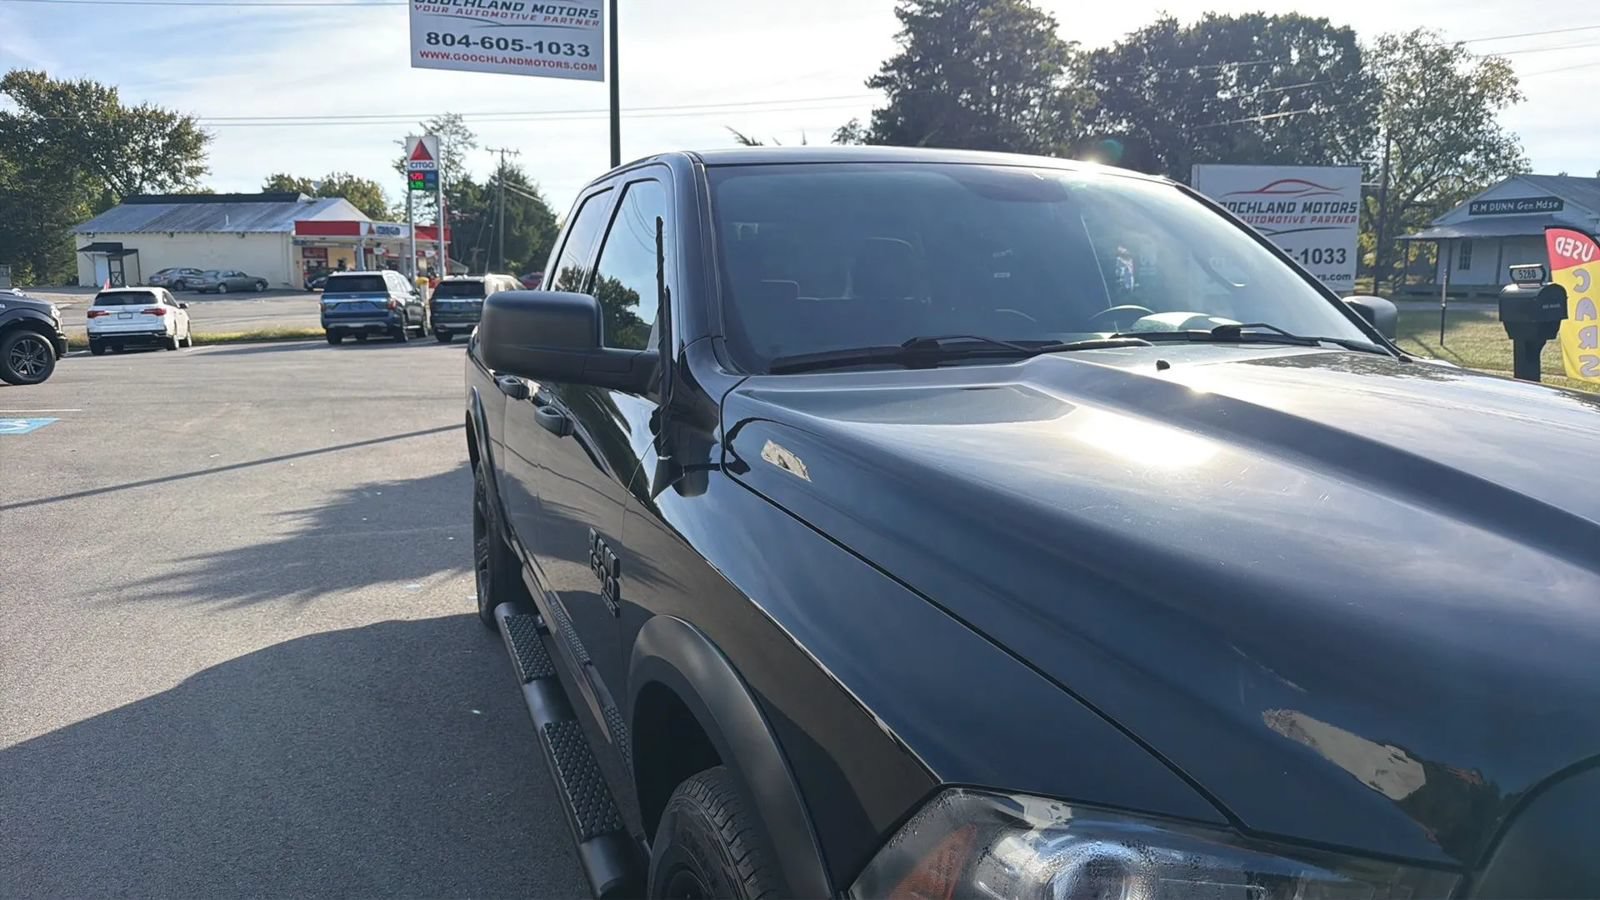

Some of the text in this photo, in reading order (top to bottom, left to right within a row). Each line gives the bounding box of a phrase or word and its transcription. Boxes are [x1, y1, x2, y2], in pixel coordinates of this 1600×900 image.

[414, 4, 600, 26] YOUR AUTOMOTIVE PARTNER
[531, 4, 600, 19] MOTORS
[426, 31, 590, 58] 804-605-1033
[420, 50, 597, 71] WWW.GOOCHLANDMOTORS.COM
[1219, 201, 1357, 213] OCHLAND MOTORS
[1489, 202, 1515, 211] DUNN
[1536, 201, 1559, 209] Mdse
[1311, 215, 1357, 224] PARTNER
